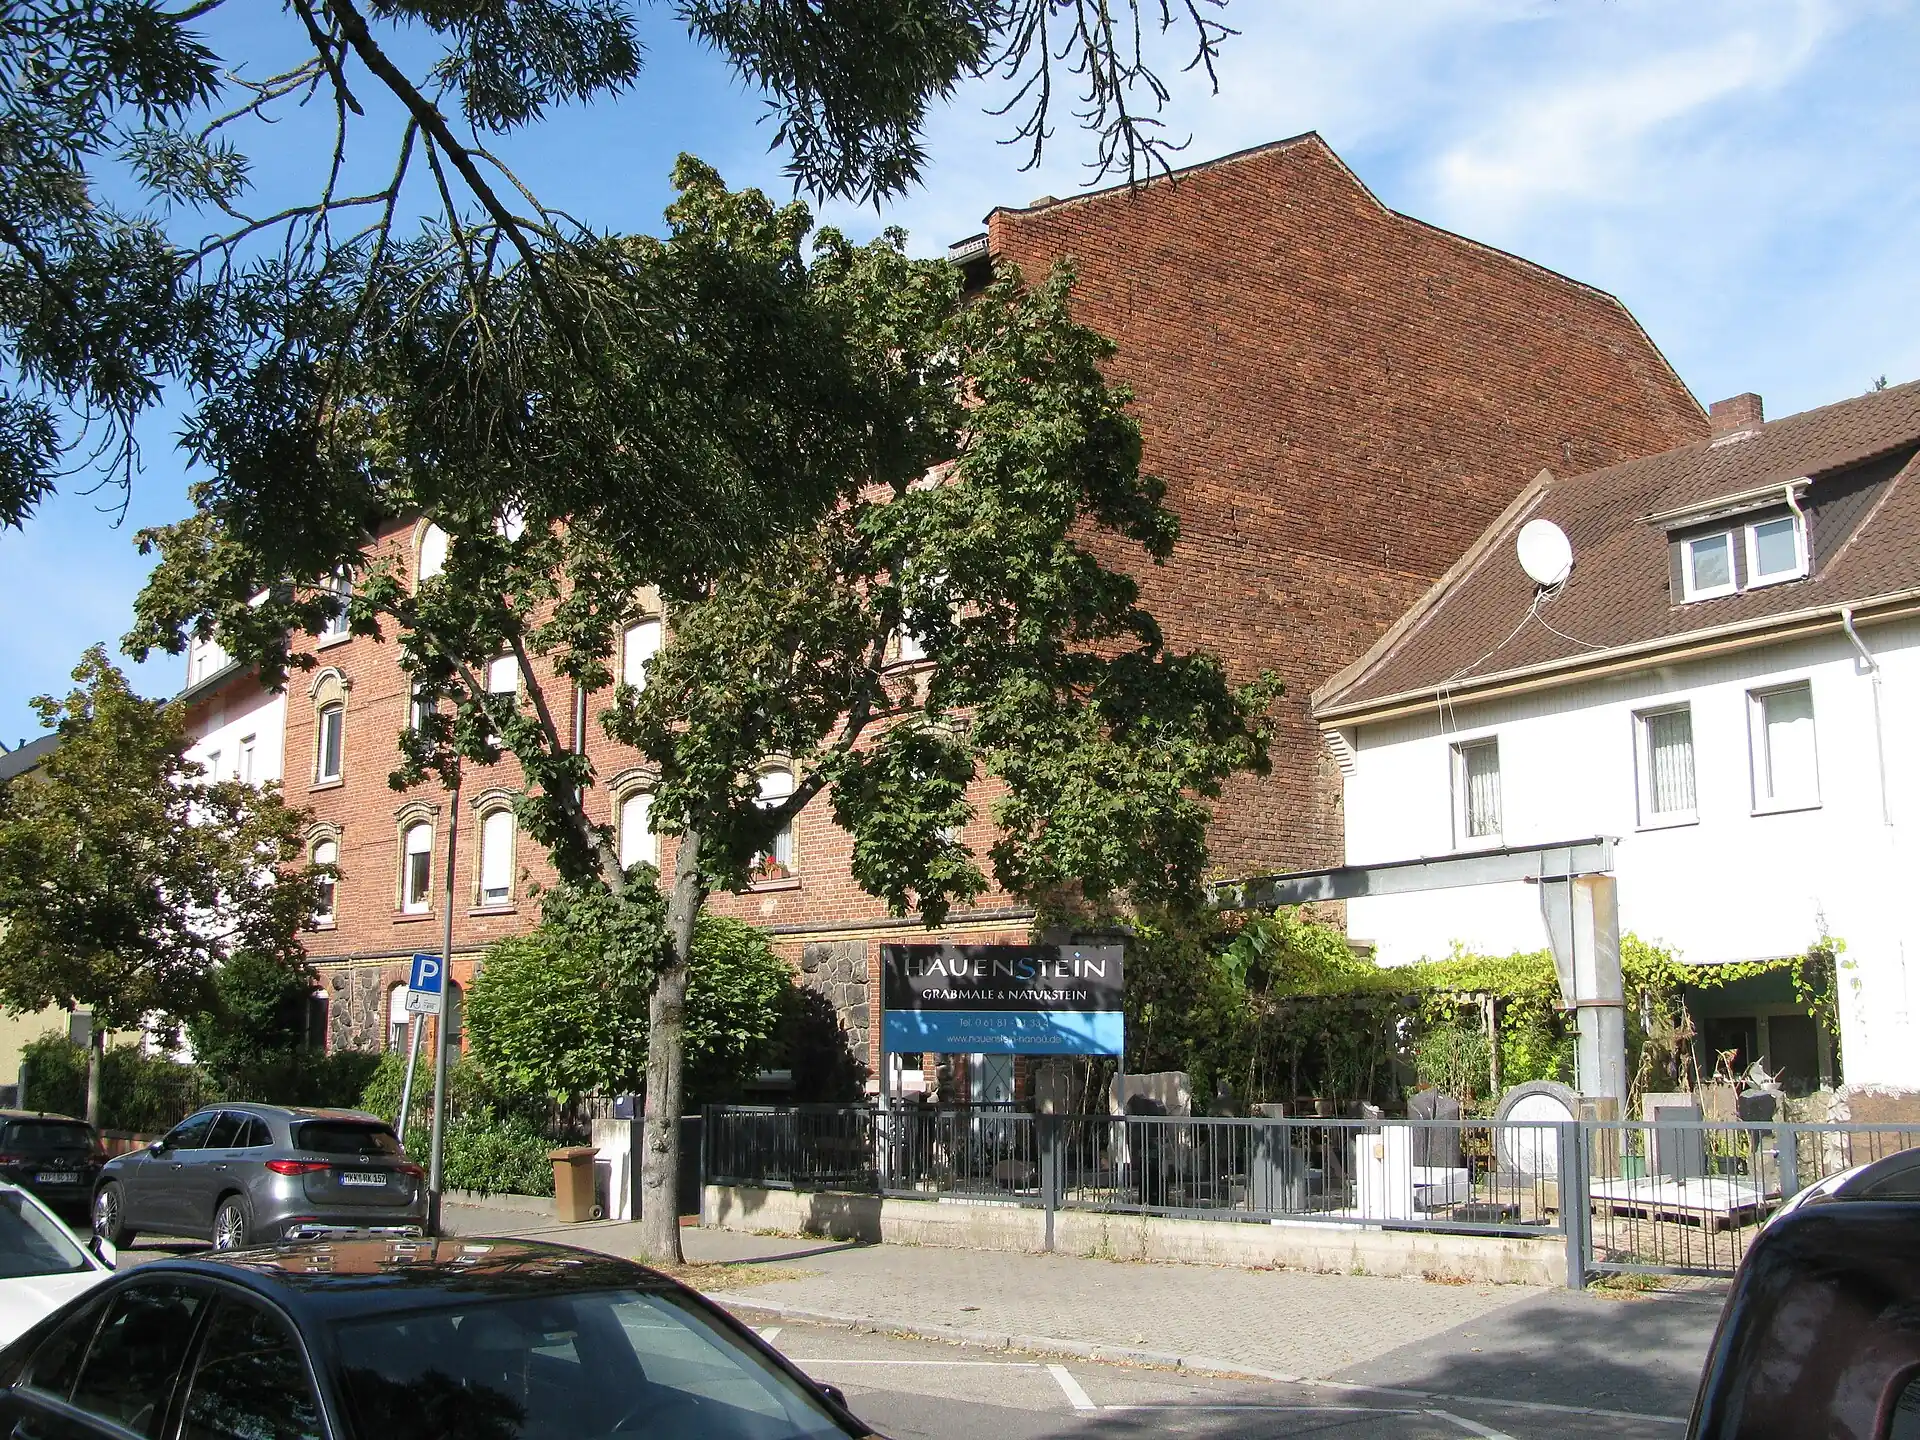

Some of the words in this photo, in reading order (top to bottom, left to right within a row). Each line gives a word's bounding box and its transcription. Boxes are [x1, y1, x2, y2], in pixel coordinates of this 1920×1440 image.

[417, 959, 439, 987] P
[922, 988, 994, 1001] GRABMALE
[997, 990, 1005, 1000] &
[1008, 988, 1087, 1001] NATURSTEIN
[959, 1017, 973, 1028] Tel.
